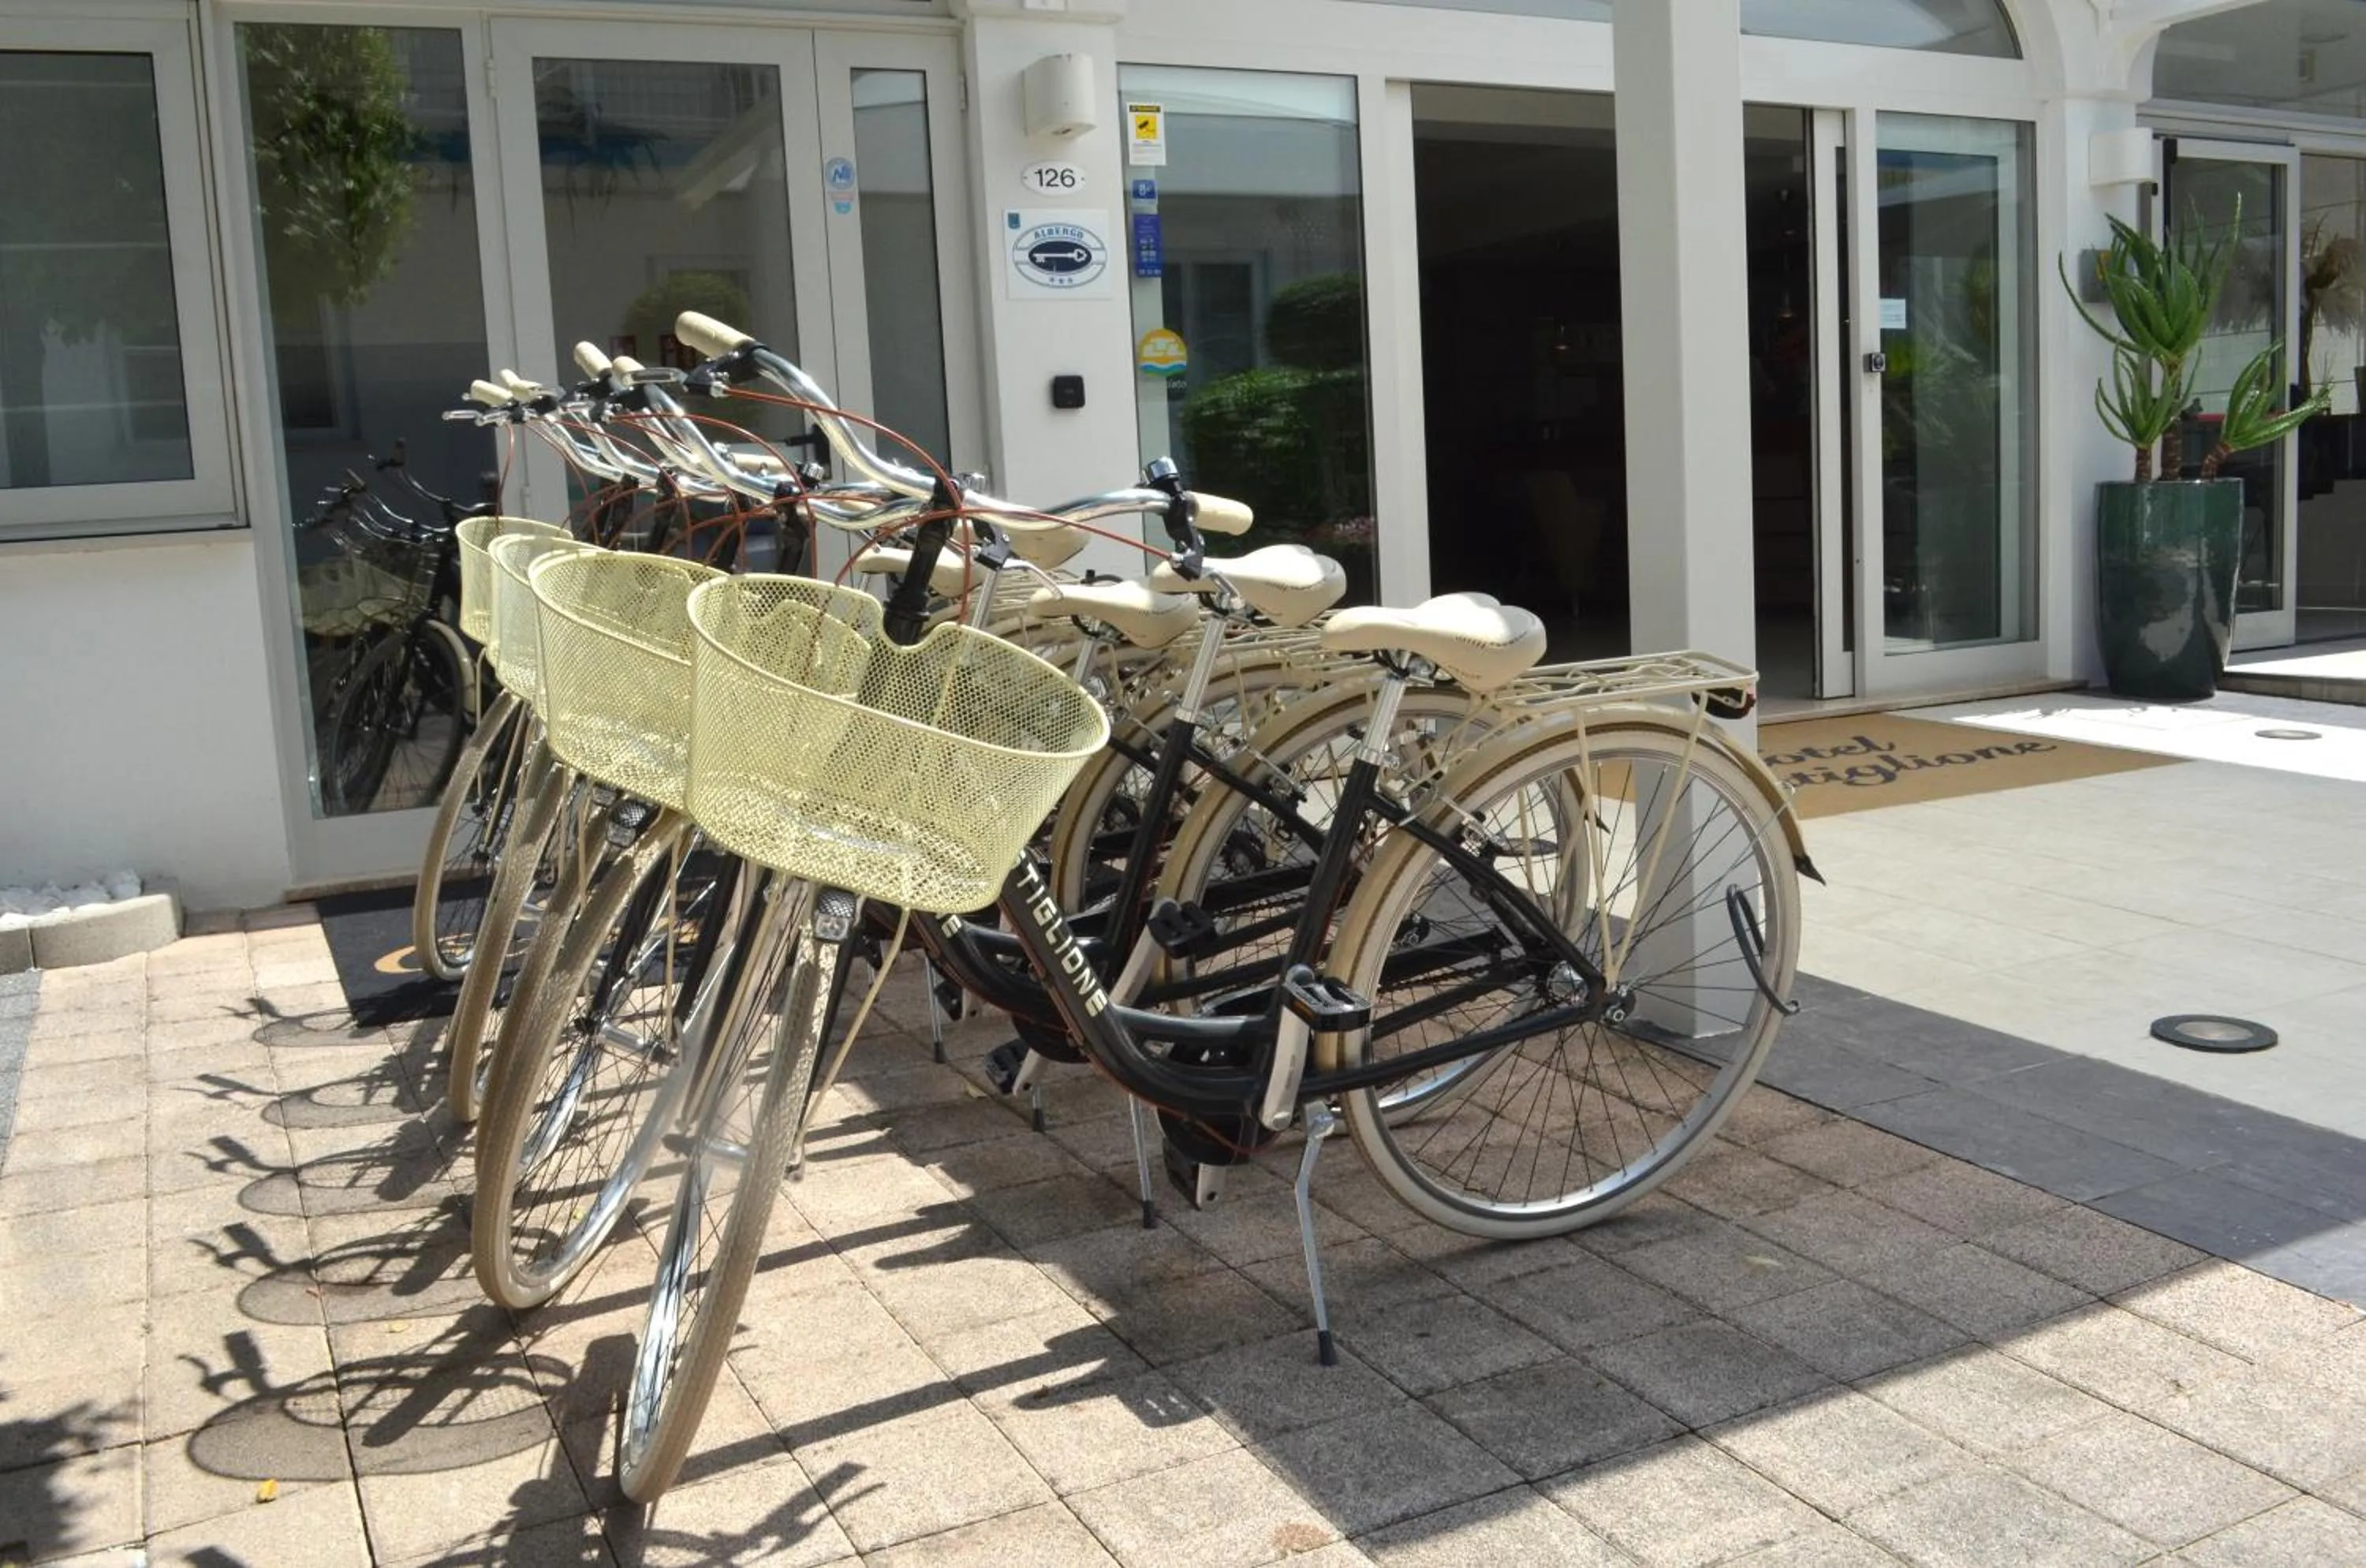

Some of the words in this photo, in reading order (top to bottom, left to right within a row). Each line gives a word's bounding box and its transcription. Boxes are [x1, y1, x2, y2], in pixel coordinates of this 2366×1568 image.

[1034, 168, 1076, 189] 126
[1034, 226, 1084, 239] ALBERGO
[1757, 735, 1896, 767] otel
